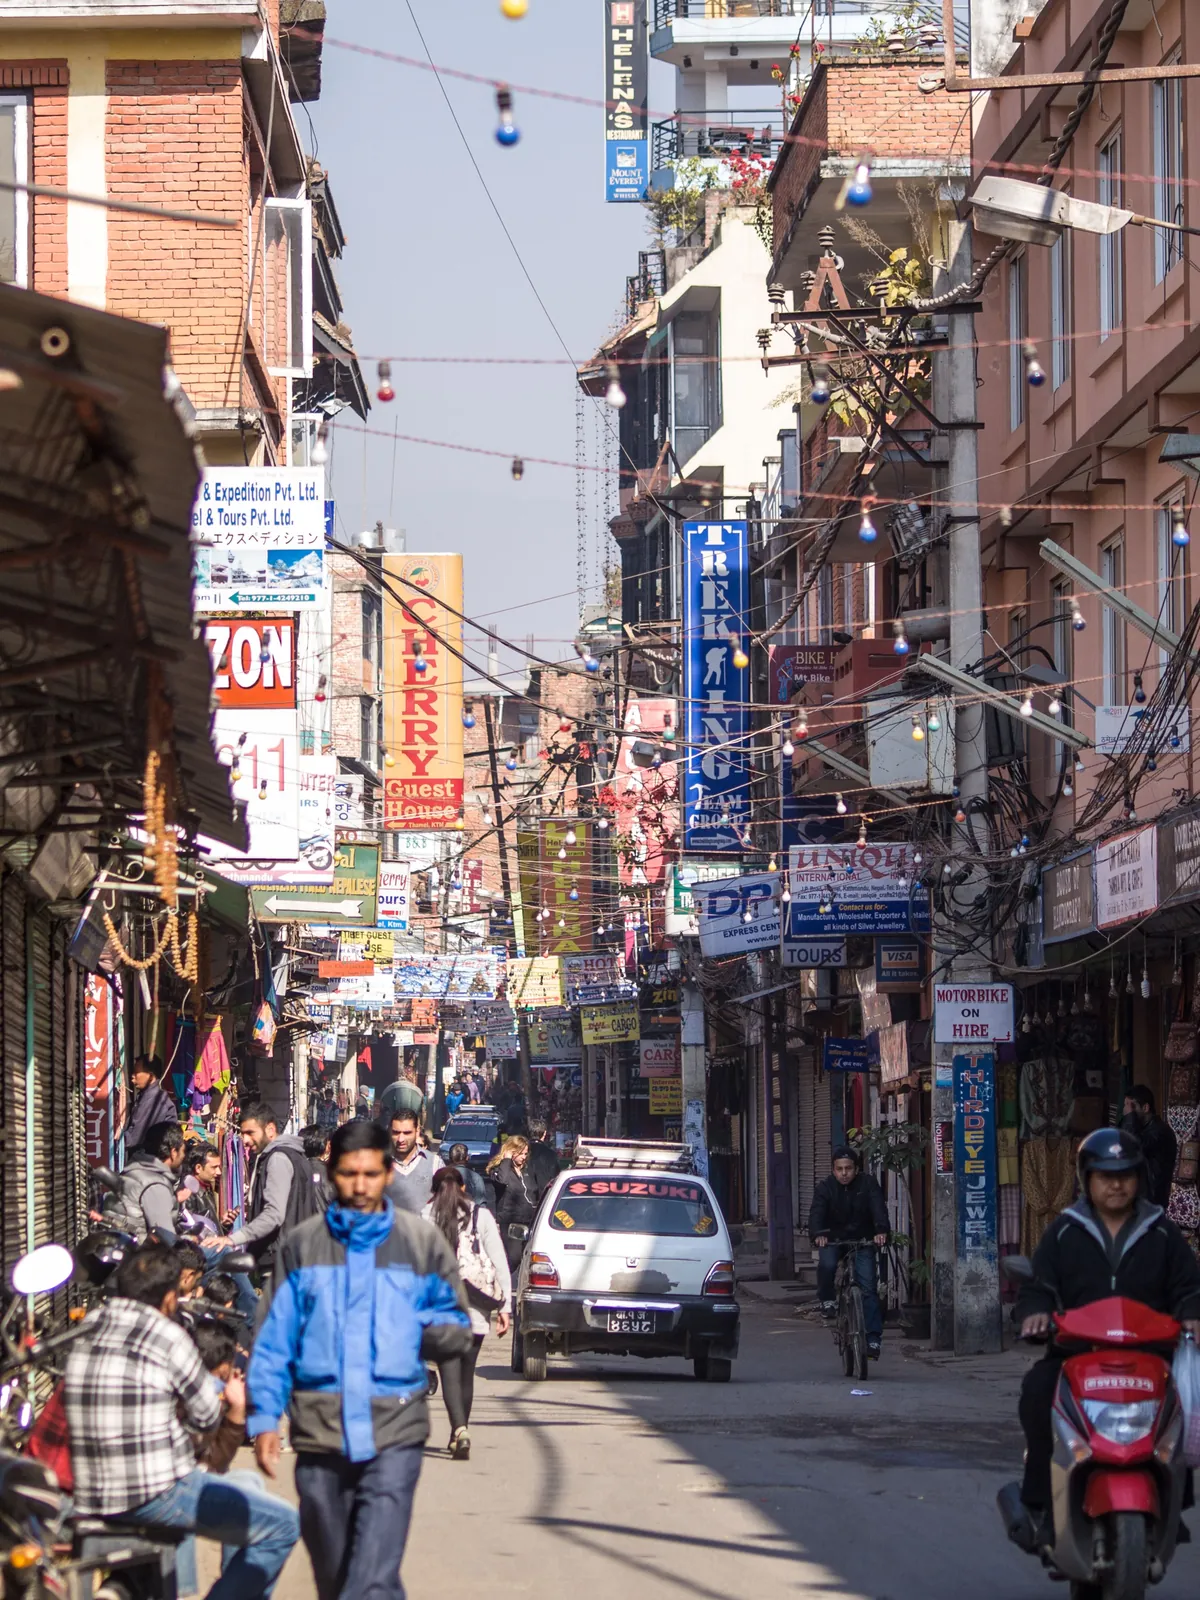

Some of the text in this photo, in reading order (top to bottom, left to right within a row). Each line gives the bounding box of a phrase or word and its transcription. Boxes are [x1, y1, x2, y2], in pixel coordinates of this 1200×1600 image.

[609, 29, 634, 129] HELENA'S
[607, 130, 644, 140] RESTAURANT
[609, 176, 643, 185] EVEREST
[611, 169, 642, 177] MOUNT
[203, 481, 319, 506] & Expedition Pvt. Ltd.
[206, 508, 214, 526] &
[217, 507, 247, 526] Tours
[250, 508, 270, 526] Pvt.
[273, 508, 294, 526] Ltd.
[796, 651, 825, 665] BIKE
[794, 674, 831, 682] Mt.Bike
[401, 598, 439, 776] CHERRY
[386, 779, 455, 798] Guest
[689, 783, 743, 811] TEAM
[386, 800, 456, 820] House
[689, 813, 744, 829] GROUP
[797, 872, 860, 883] INTERNATIONAL
[797, 913, 837, 921] Manufacture,
[838, 912, 874, 921] Wholesaler,
[874, 912, 900, 920] Exporter
[723, 922, 781, 939] EXPRESS CENT
[832, 923, 849, 931] kinds
[857, 922, 876, 931] Silver
[876, 922, 906, 931] Jewellery.
[366, 932, 391, 940] GUEST
[788, 948, 842, 963] TOURS
[887, 951, 913, 962] VISA
[936, 988, 1009, 1002] MOTORBIKE
[961, 1008, 980, 1018] ON
[611, 1017, 637, 1032] CARGO
[952, 1023, 989, 1038] HIRE
[963, 1055, 985, 1129] THIRD
[935, 1122, 943, 1171] ABSOLUTION
[964, 1131, 986, 1174] EYE
[591, 1181, 698, 1200] SUZUKI
[556, 1211, 574, 1228] TAXI
